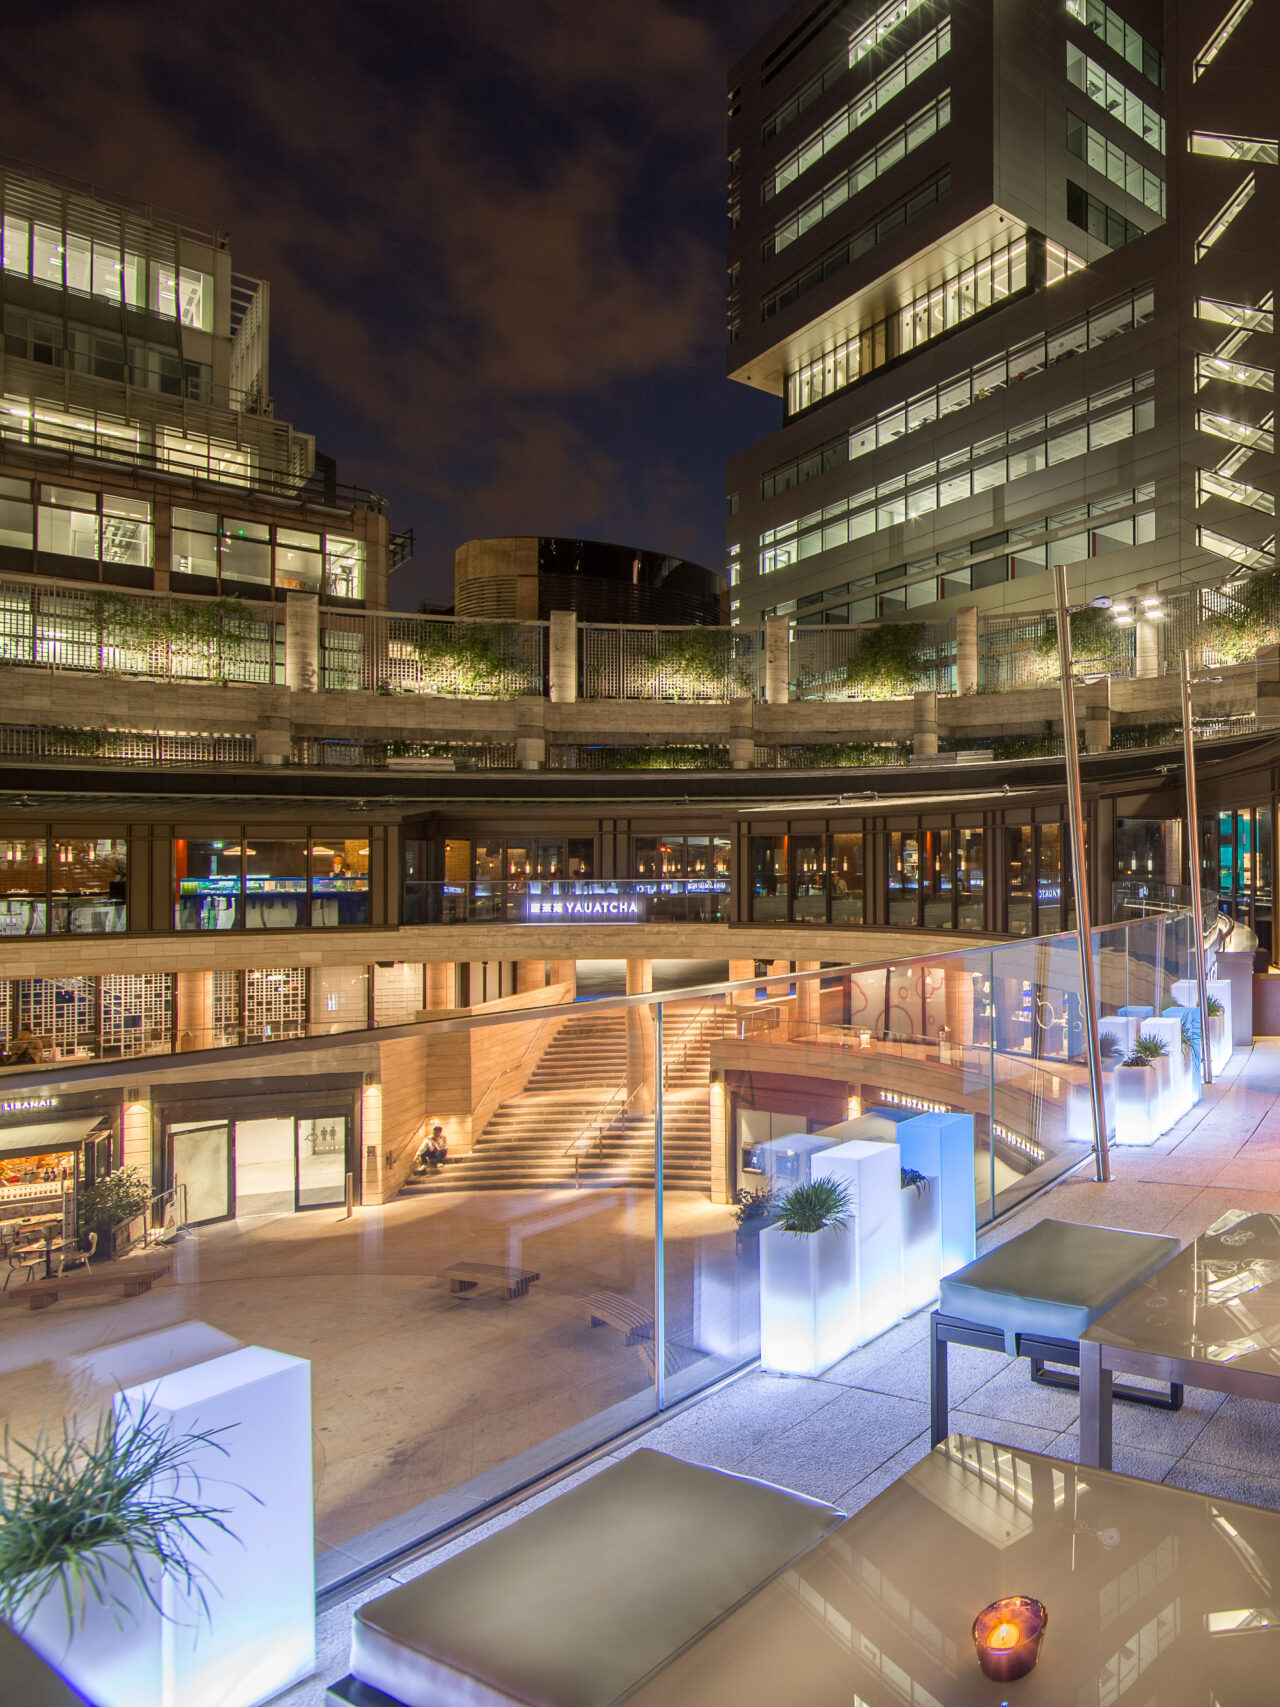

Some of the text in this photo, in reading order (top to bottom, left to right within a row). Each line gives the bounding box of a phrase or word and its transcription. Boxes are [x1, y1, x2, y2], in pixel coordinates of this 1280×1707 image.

[566, 902, 638, 913] YAUATCHA
[880, 1091, 898, 1104] THE
[3, 1098, 57, 1111] LIBANAIS
